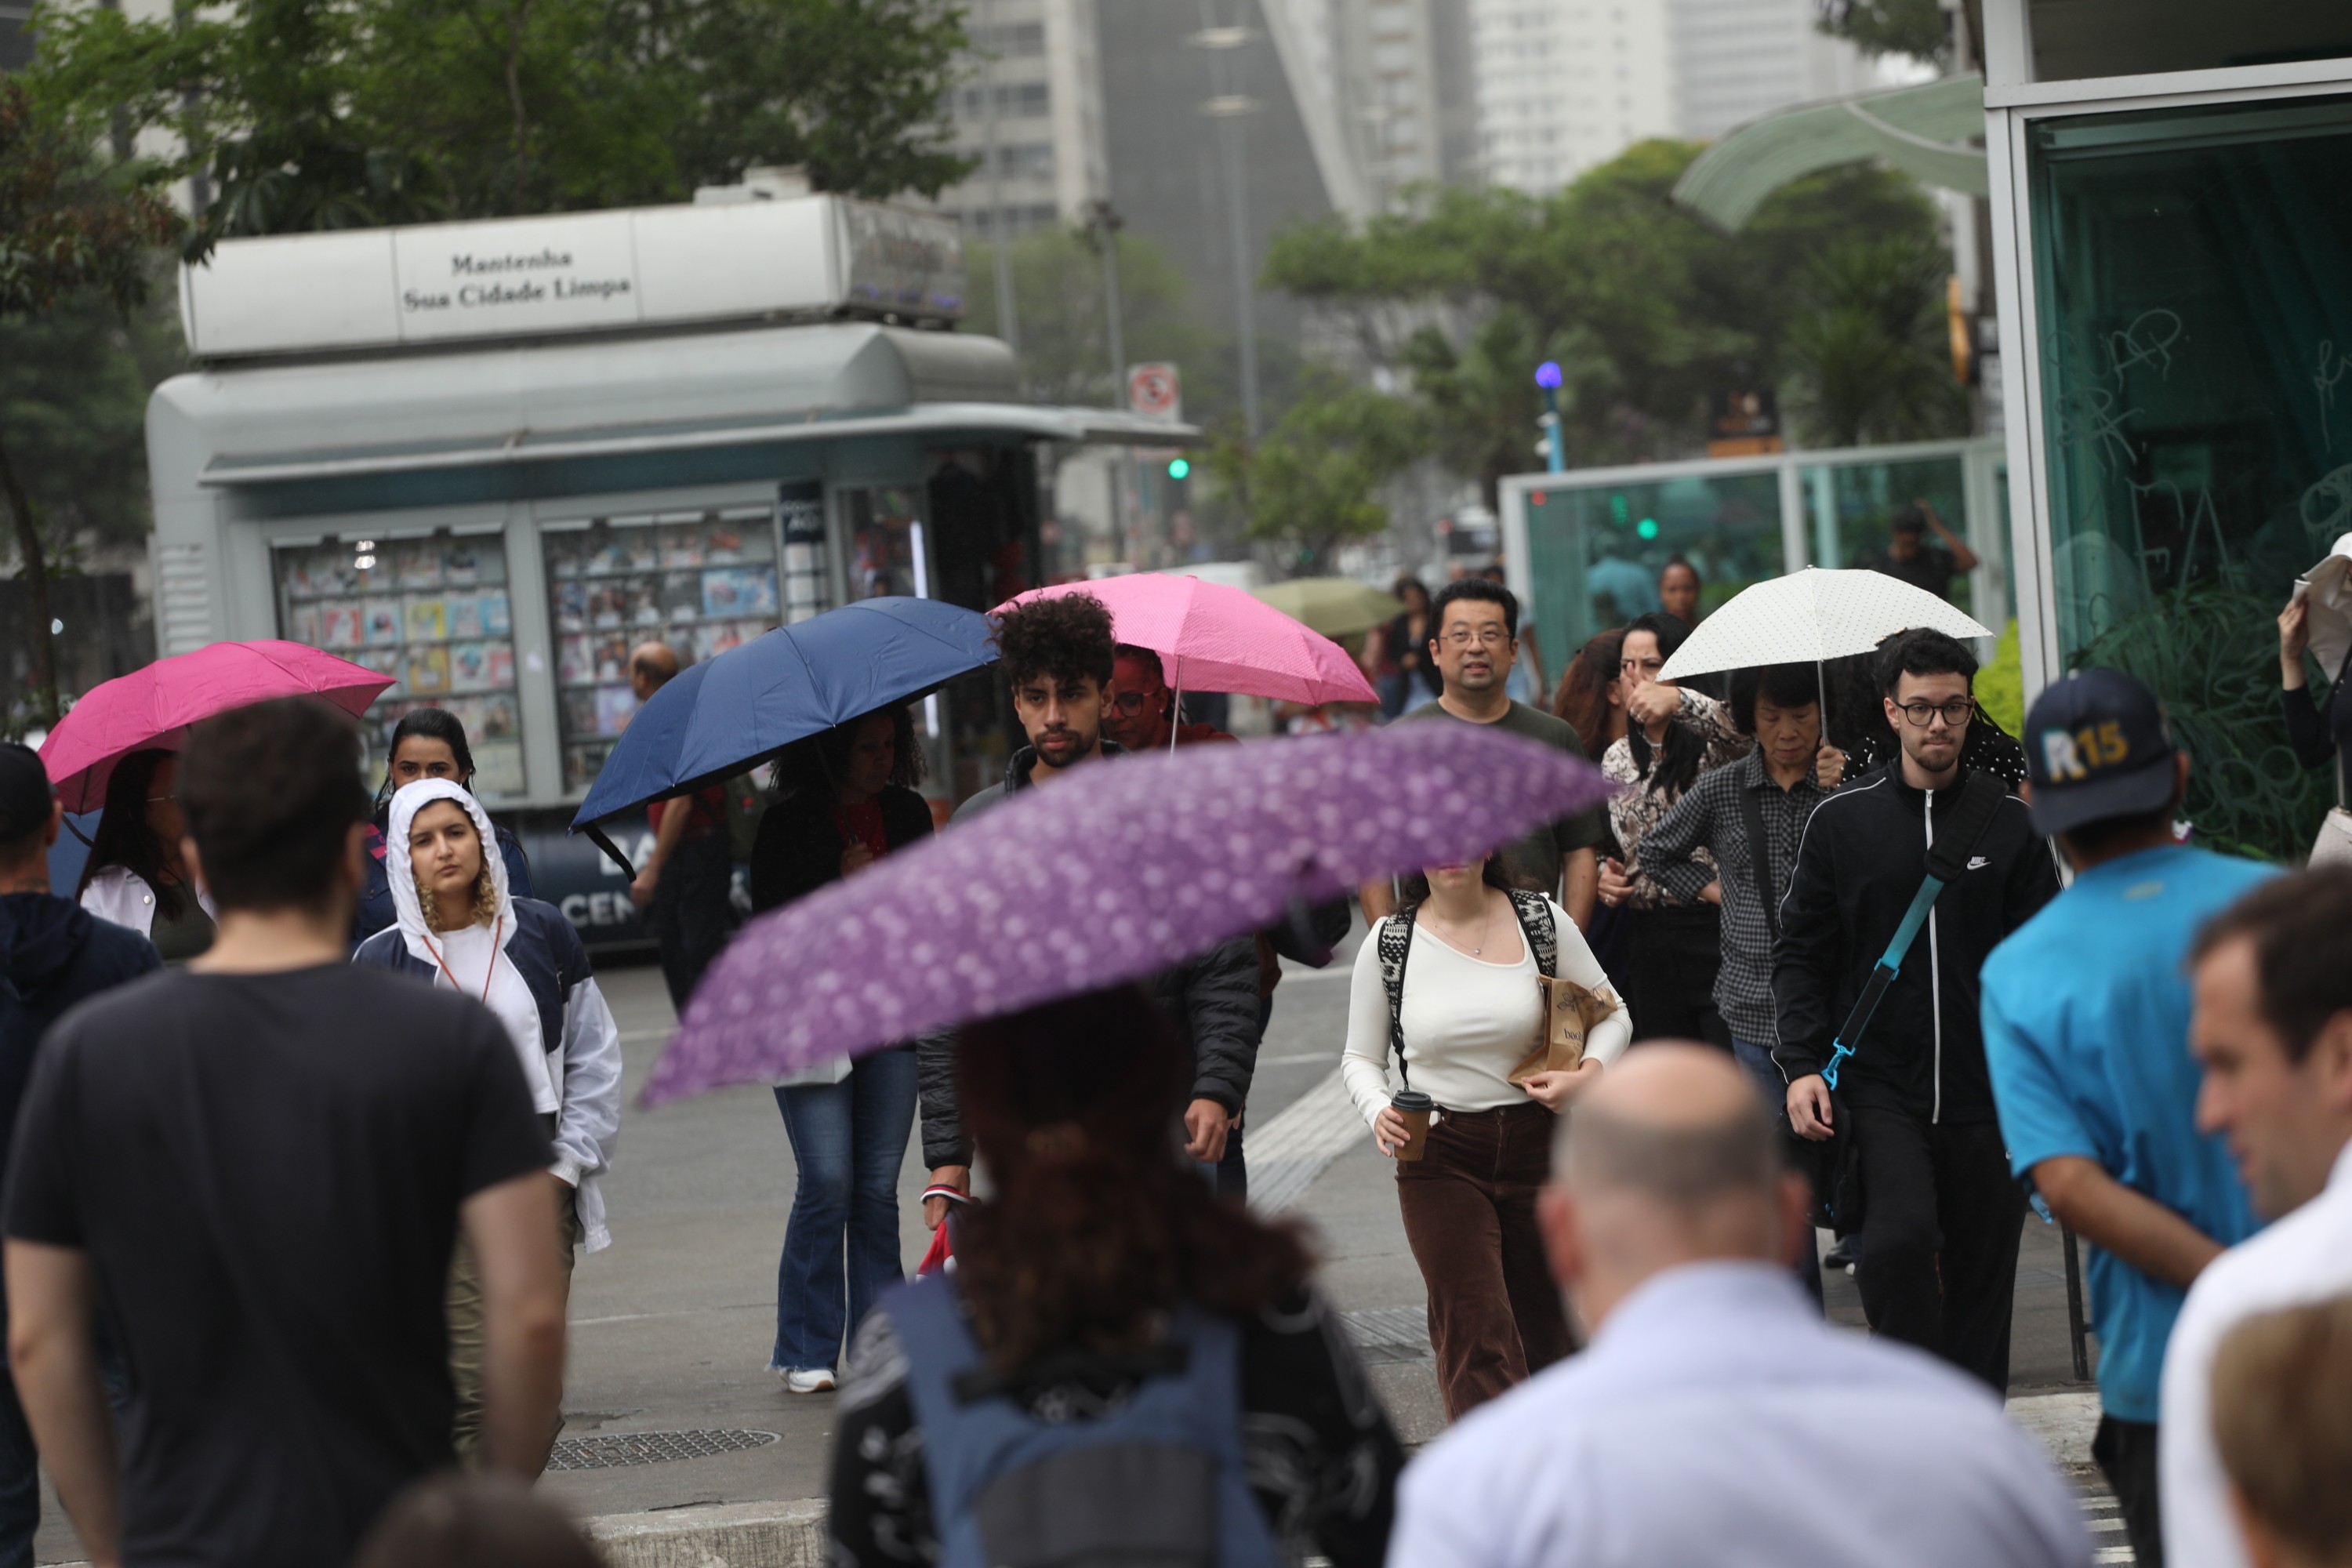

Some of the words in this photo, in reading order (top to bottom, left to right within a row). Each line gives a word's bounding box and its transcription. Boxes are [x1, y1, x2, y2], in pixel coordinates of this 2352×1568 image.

[452, 249, 572, 276] Mantenha
[404, 289, 450, 311] Sua
[459, 281, 544, 307] Cidade
[554, 278, 630, 299] Limpa
[2042, 720, 2129, 782] R15
[1971, 856, 1986, 865] NIKE
